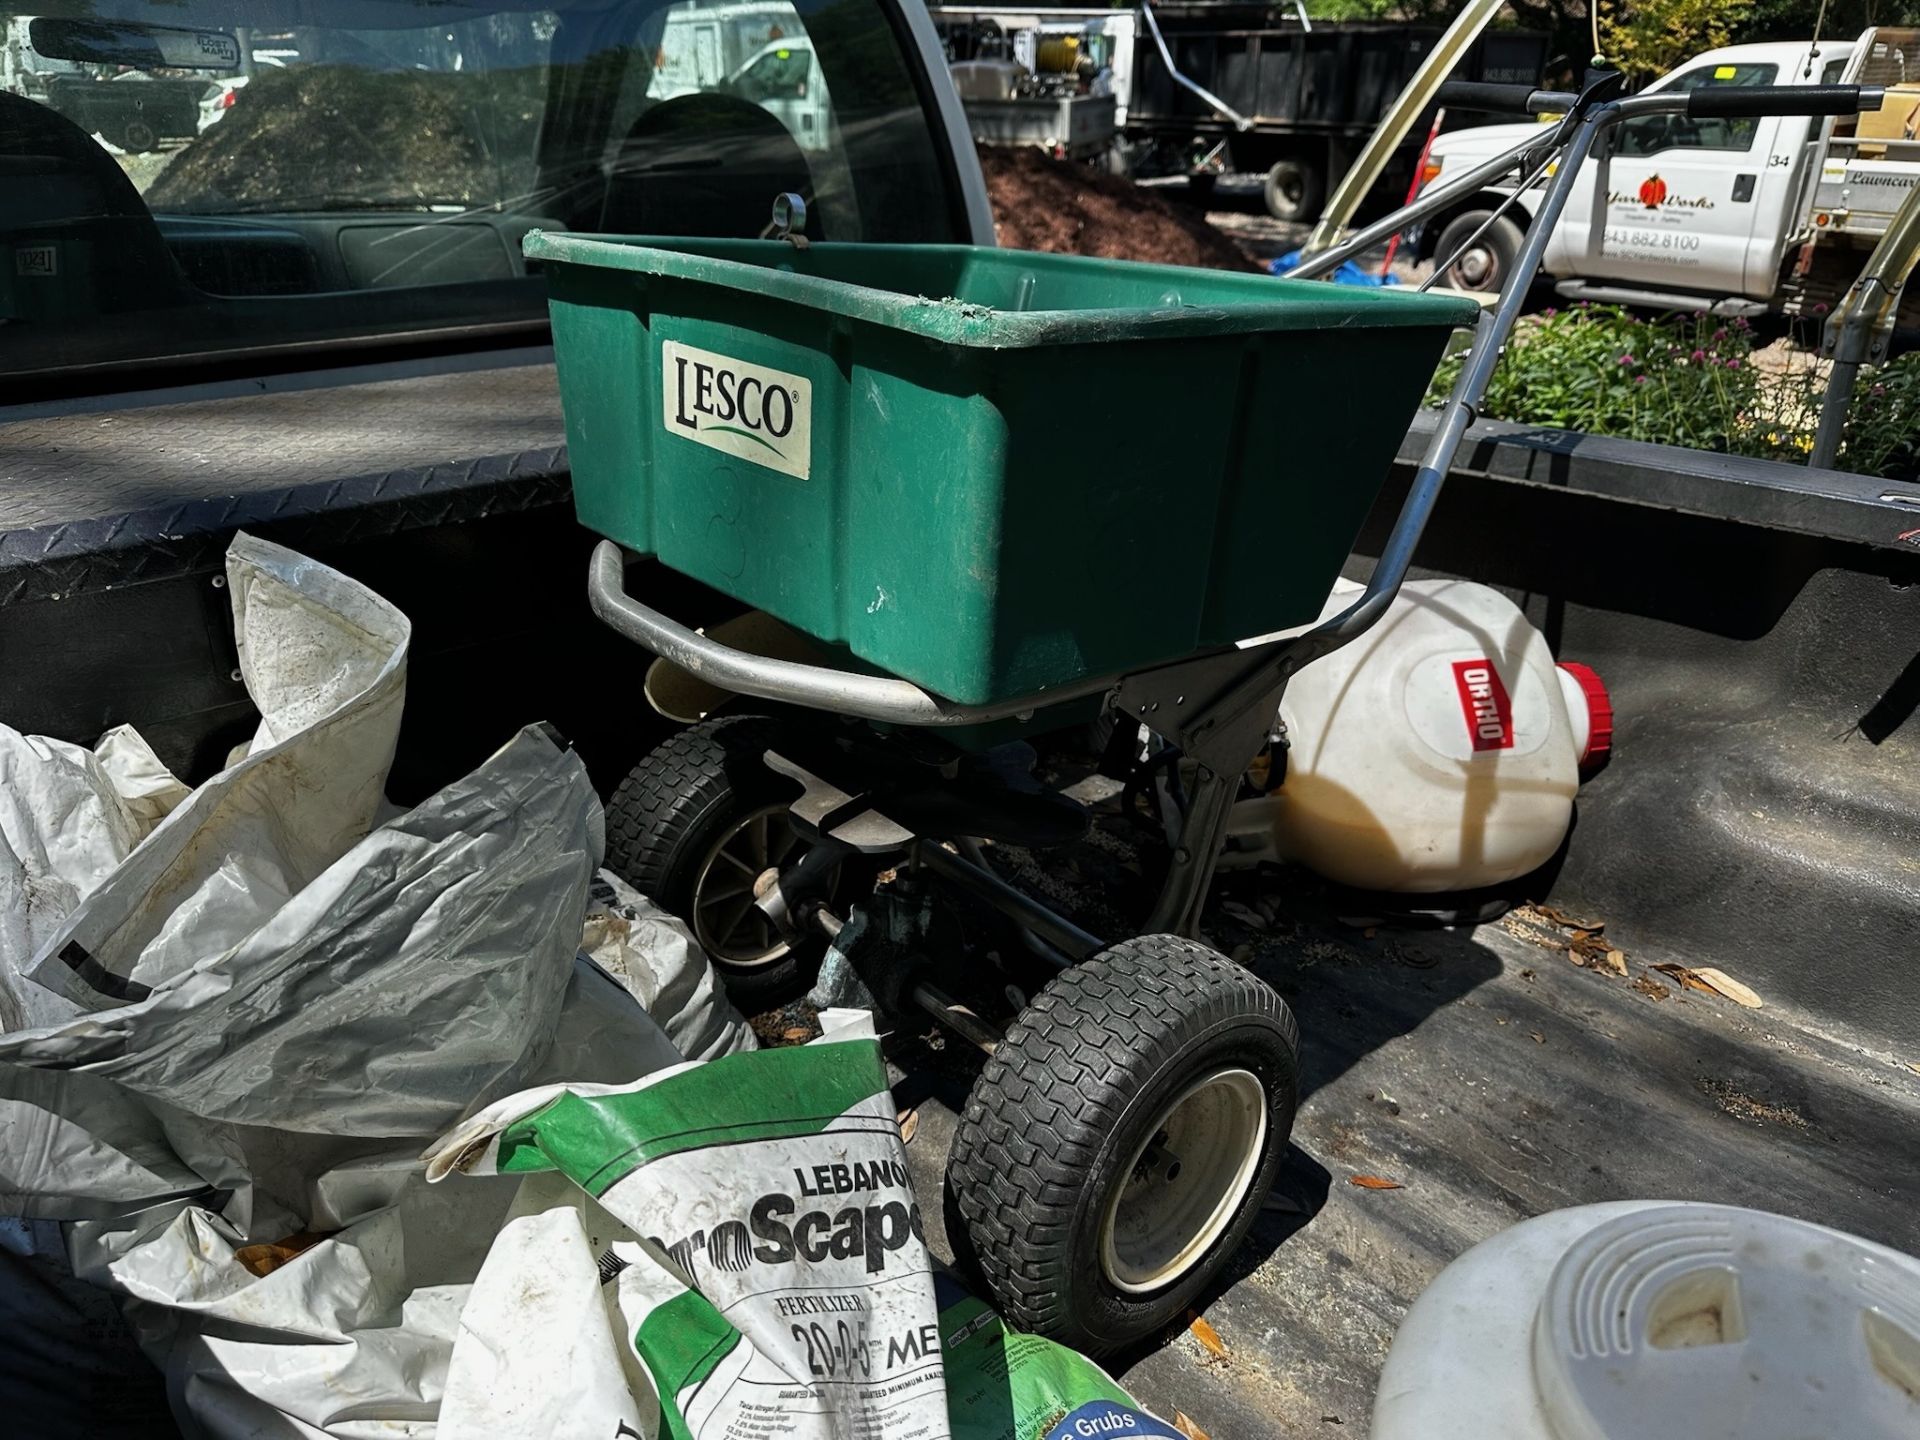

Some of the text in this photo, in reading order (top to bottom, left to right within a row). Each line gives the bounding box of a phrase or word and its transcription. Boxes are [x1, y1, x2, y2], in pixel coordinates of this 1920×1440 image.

[202, 39, 228, 48] LOST
[202, 47, 231, 56] MARY
[1770, 154, 1790, 168] 34
[675, 356, 794, 439] LESCO
[1463, 667, 1505, 740] ORTHO
[774, 1294, 866, 1316] FERTILIZER
[791, 1319, 871, 1377] 20-0-5
[888, 1376, 923, 1394] MINIMUM
[1075, 1410, 1136, 1437] Grubs
